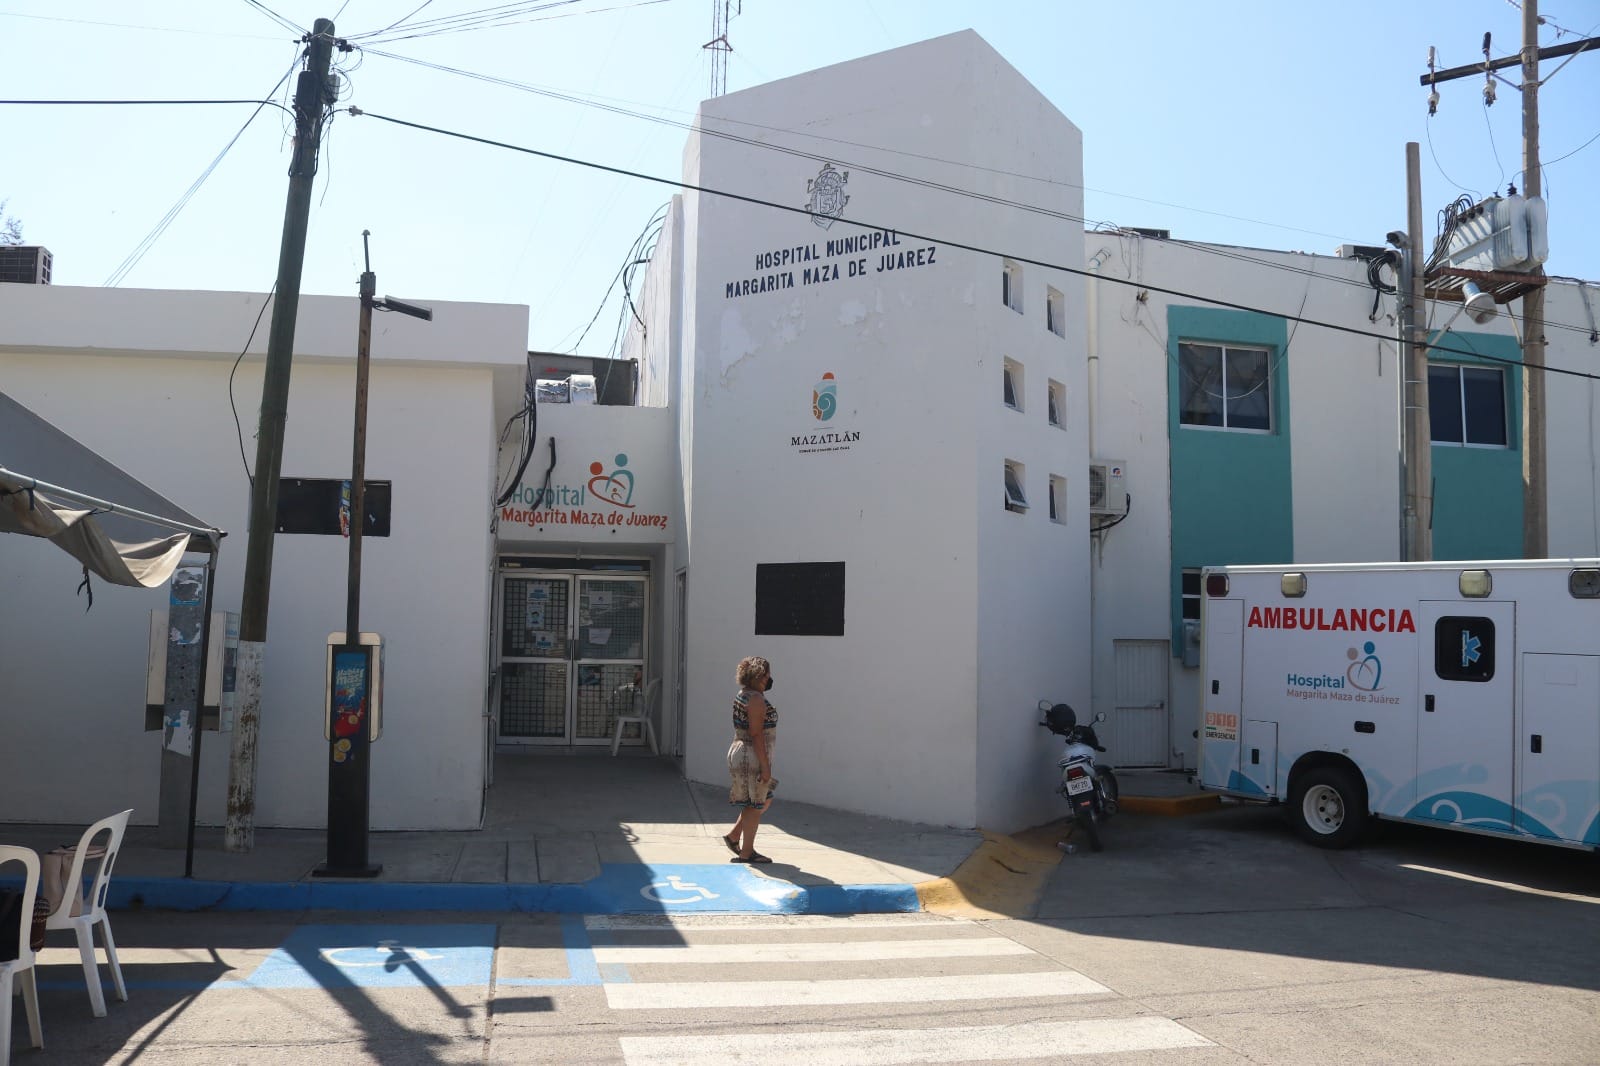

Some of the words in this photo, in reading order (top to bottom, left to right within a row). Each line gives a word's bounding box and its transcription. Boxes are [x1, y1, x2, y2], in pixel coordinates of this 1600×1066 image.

[756, 244, 820, 270] HOSPITAL
[827, 229, 900, 257] MUNICIPAL
[726, 271, 794, 299] MARGARITA
[803, 264, 839, 286] MAZA
[849, 259, 867, 278] DE
[877, 247, 936, 273] JUAREZ
[791, 431, 860, 446] MAZATLÁN
[512, 482, 585, 508] Hospital
[502, 508, 567, 527] Margarita
[570, 510, 604, 528] Maza
[607, 511, 623, 526] de
[626, 512, 668, 530] Juarez
[1247, 606, 1416, 633] AMBULANCIA
[1287, 673, 1345, 690] Hospital
[1286, 689, 1328, 701] Margarita
[1330, 691, 1353, 702] Maza
[1355, 692, 1367, 702] de
[1368, 694, 1400, 705] Juárez
[1206, 712, 1236, 727] 911
